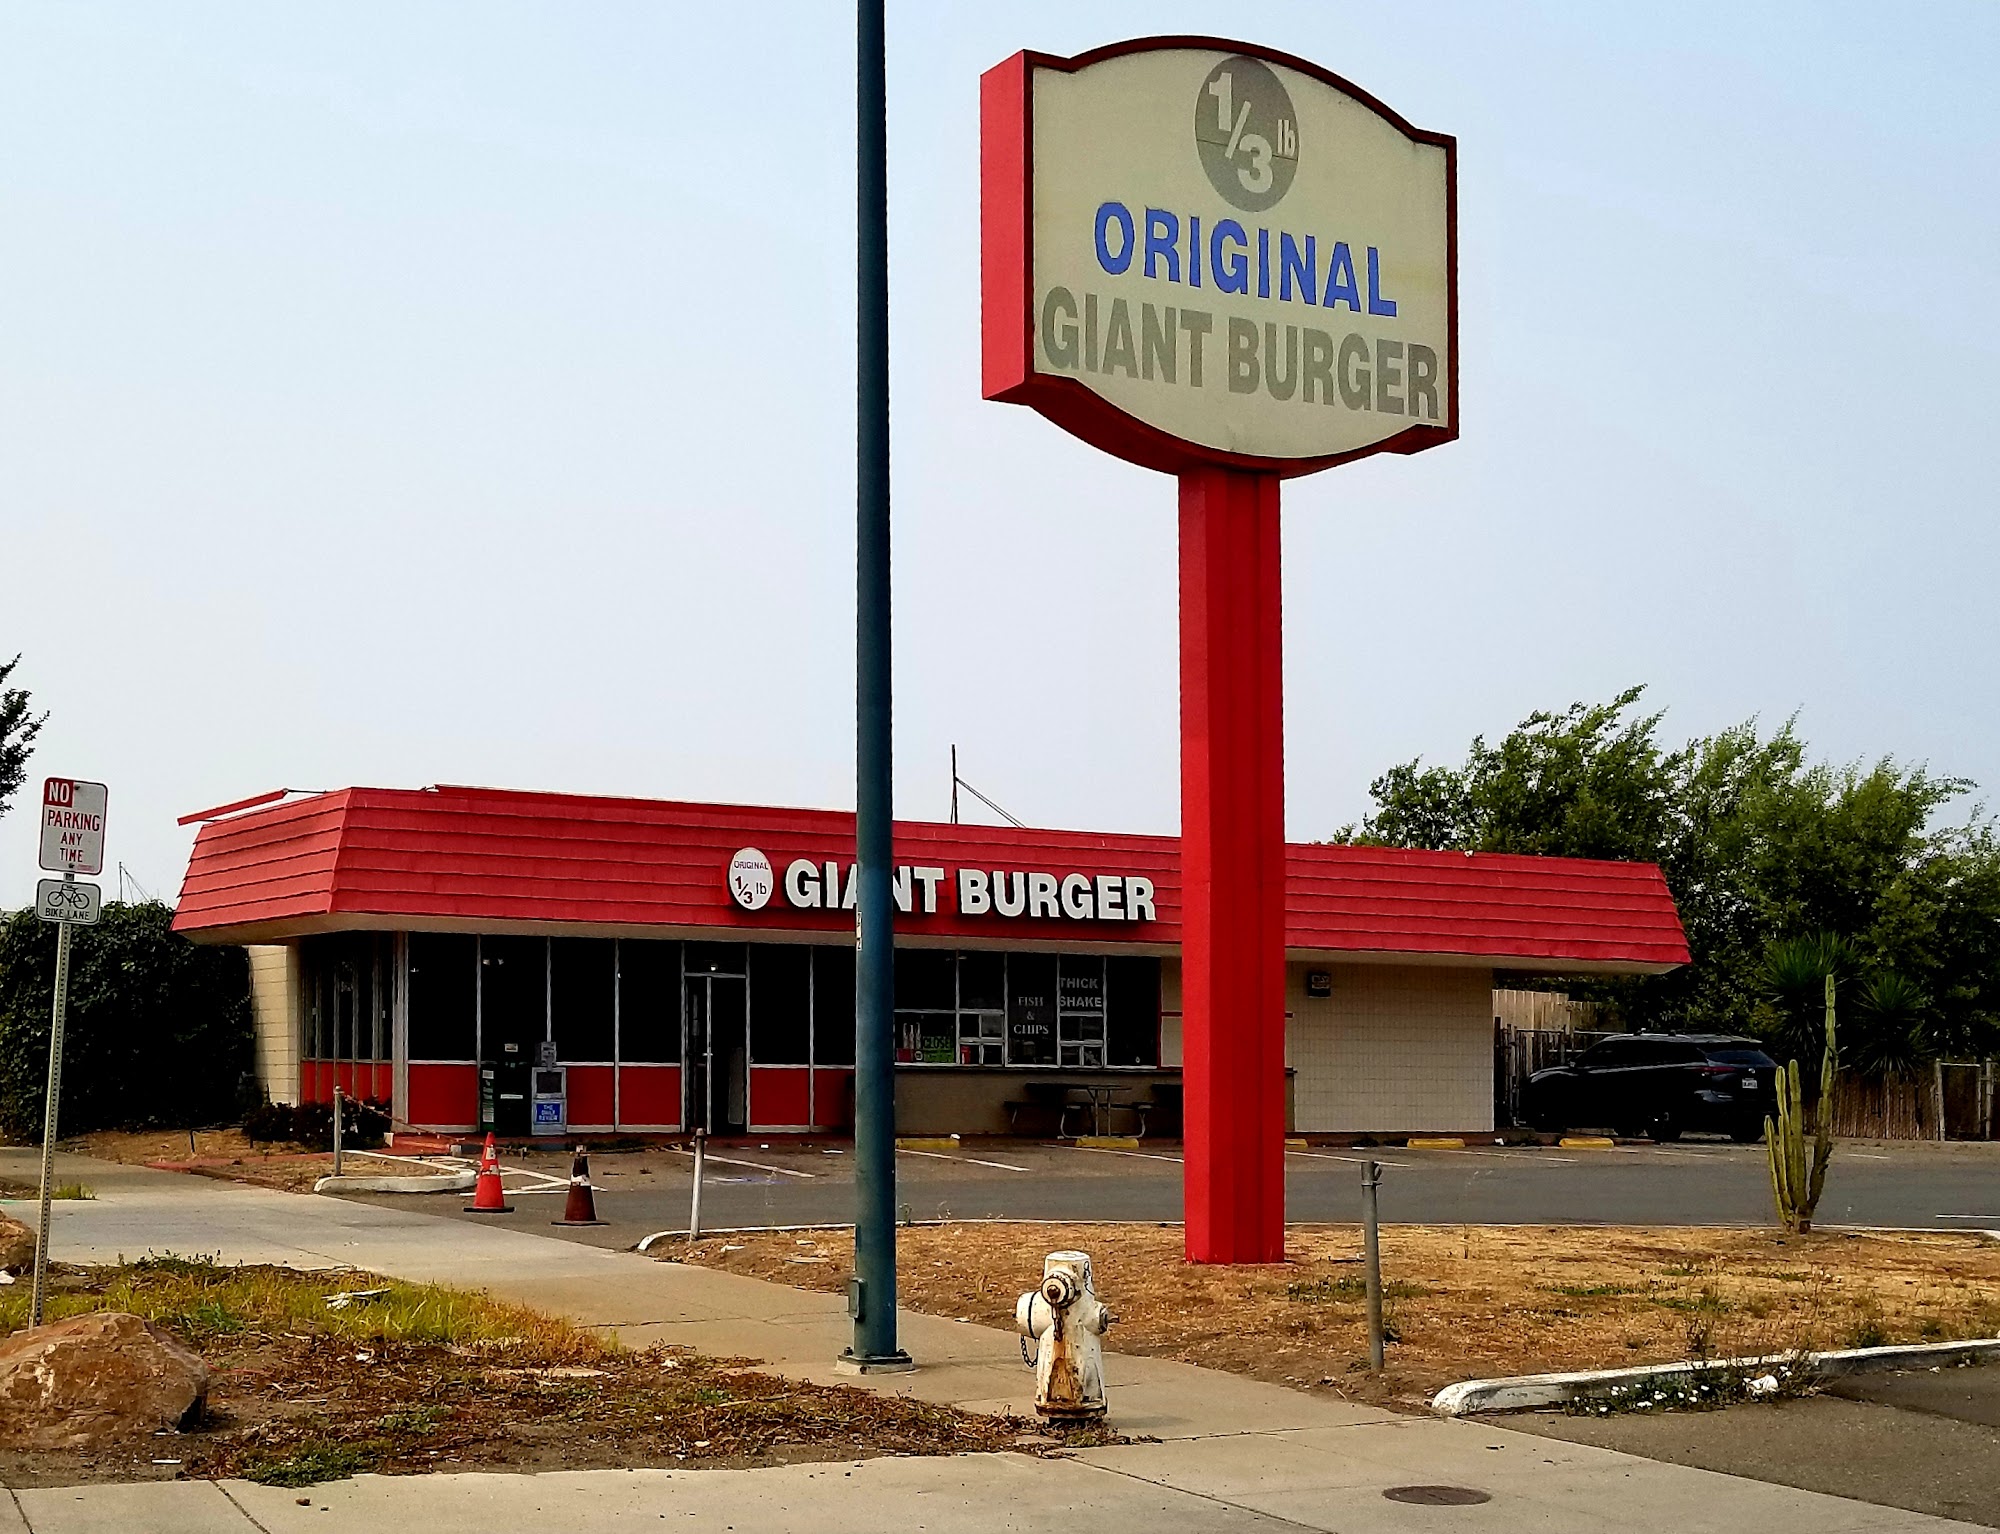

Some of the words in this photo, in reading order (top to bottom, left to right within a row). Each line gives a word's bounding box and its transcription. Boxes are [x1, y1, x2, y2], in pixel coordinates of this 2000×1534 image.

[1276, 119, 1296, 157] lb
[1095, 201, 1398, 318] ORIGINAL
[1042, 286, 1213, 388] GIANT
[1227, 316, 1439, 419] BURGER
[48, 781, 70, 803] NO
[47, 809, 101, 832] PARKING
[60, 832, 83, 846] ANY
[59, 847, 84, 863] TIME
[733, 860, 769, 870] ORIGINAL
[755, 882, 767, 895] lb
[958, 868, 1157, 922] BURGER
[45, 907, 64, 918] BIKE
[67, 909, 90, 920] LANE
[1060, 977, 1099, 990] THICK
[1017, 996, 1044, 1007] FISH
[1059, 996, 1103, 1008] SHAKE
[1026, 1010, 1036, 1021] &
[1013, 1024, 1050, 1035] CHIPS
